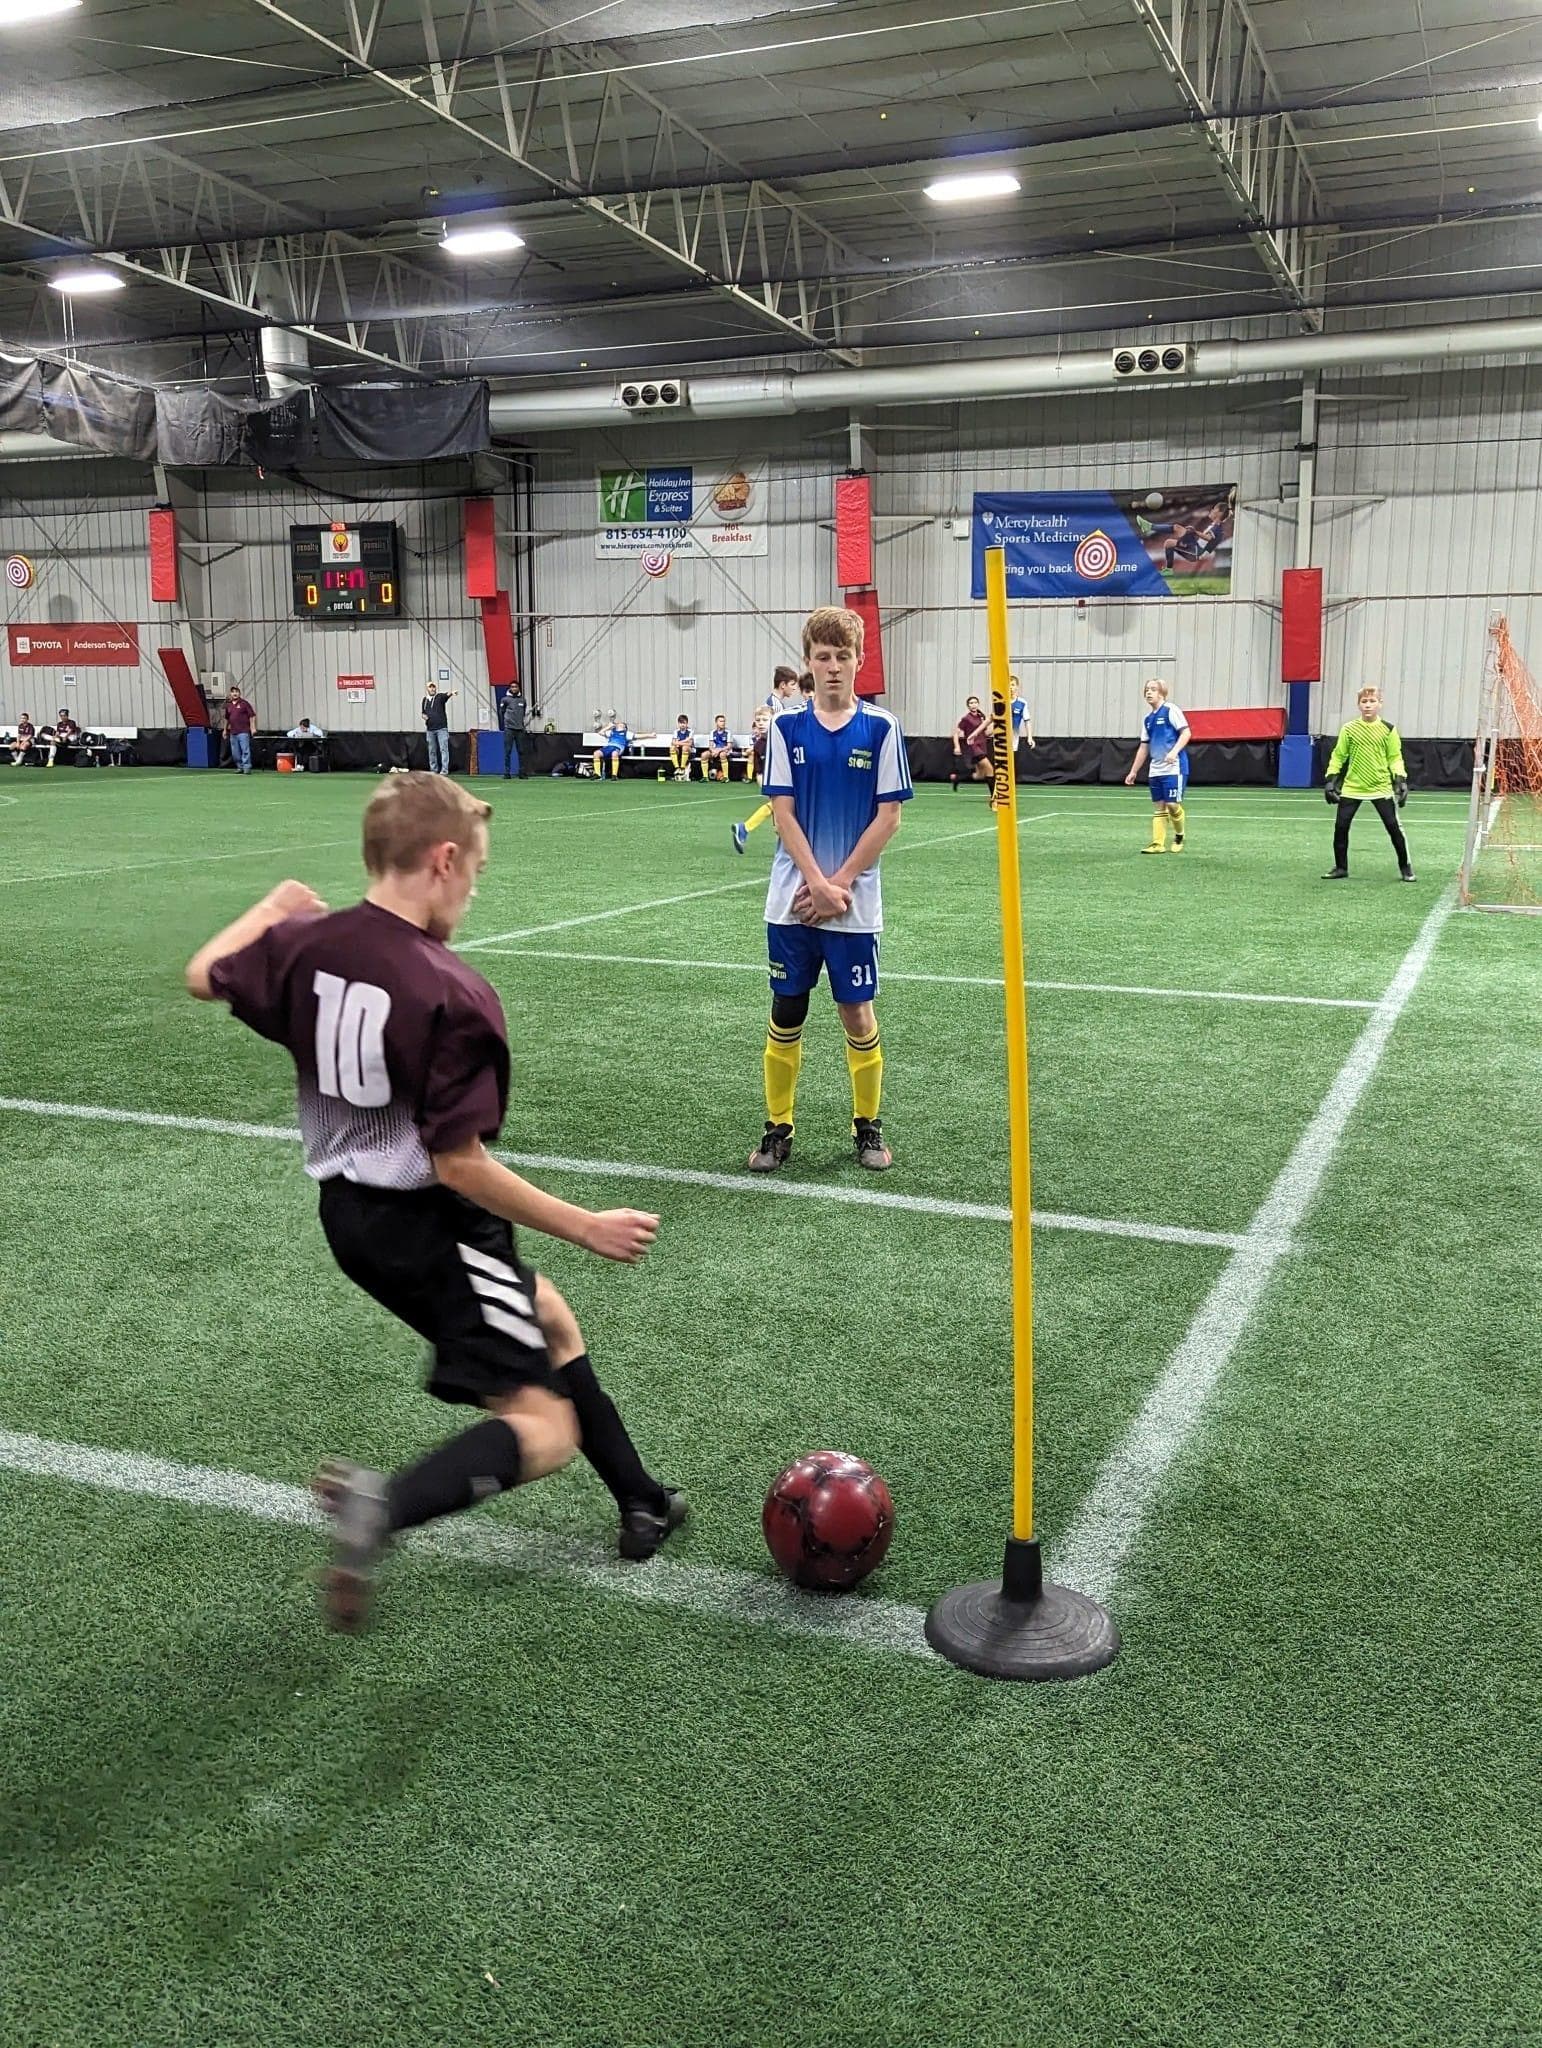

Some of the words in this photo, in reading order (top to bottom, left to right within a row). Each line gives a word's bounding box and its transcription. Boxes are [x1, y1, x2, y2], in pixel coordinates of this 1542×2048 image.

[649, 478, 678, 488] Holiday
[679, 478, 691, 486] Inn
[649, 490, 689, 503] Express
[995, 514, 1067, 531] Mercyhealth
[606, 528, 687, 539] 815-654-4100
[712, 533, 752, 542] Breakfast
[994, 532, 1030, 545] Sports
[1034, 531, 1086, 543] Medicine
[1027, 566, 1045, 575] you
[1049, 563, 1073, 573] back
[307, 585, 318, 604] 0
[381, 583, 392, 603] 0
[333, 600, 353, 610] period
[360, 598, 365, 611] 1
[32, 641, 62, 649] TOYOTA
[74, 641, 106, 649] Anderson
[107, 641, 130, 650] Toyota
[793, 746, 806, 764] 31
[851, 964, 873, 987] 31
[313, 969, 392, 1108] 10
